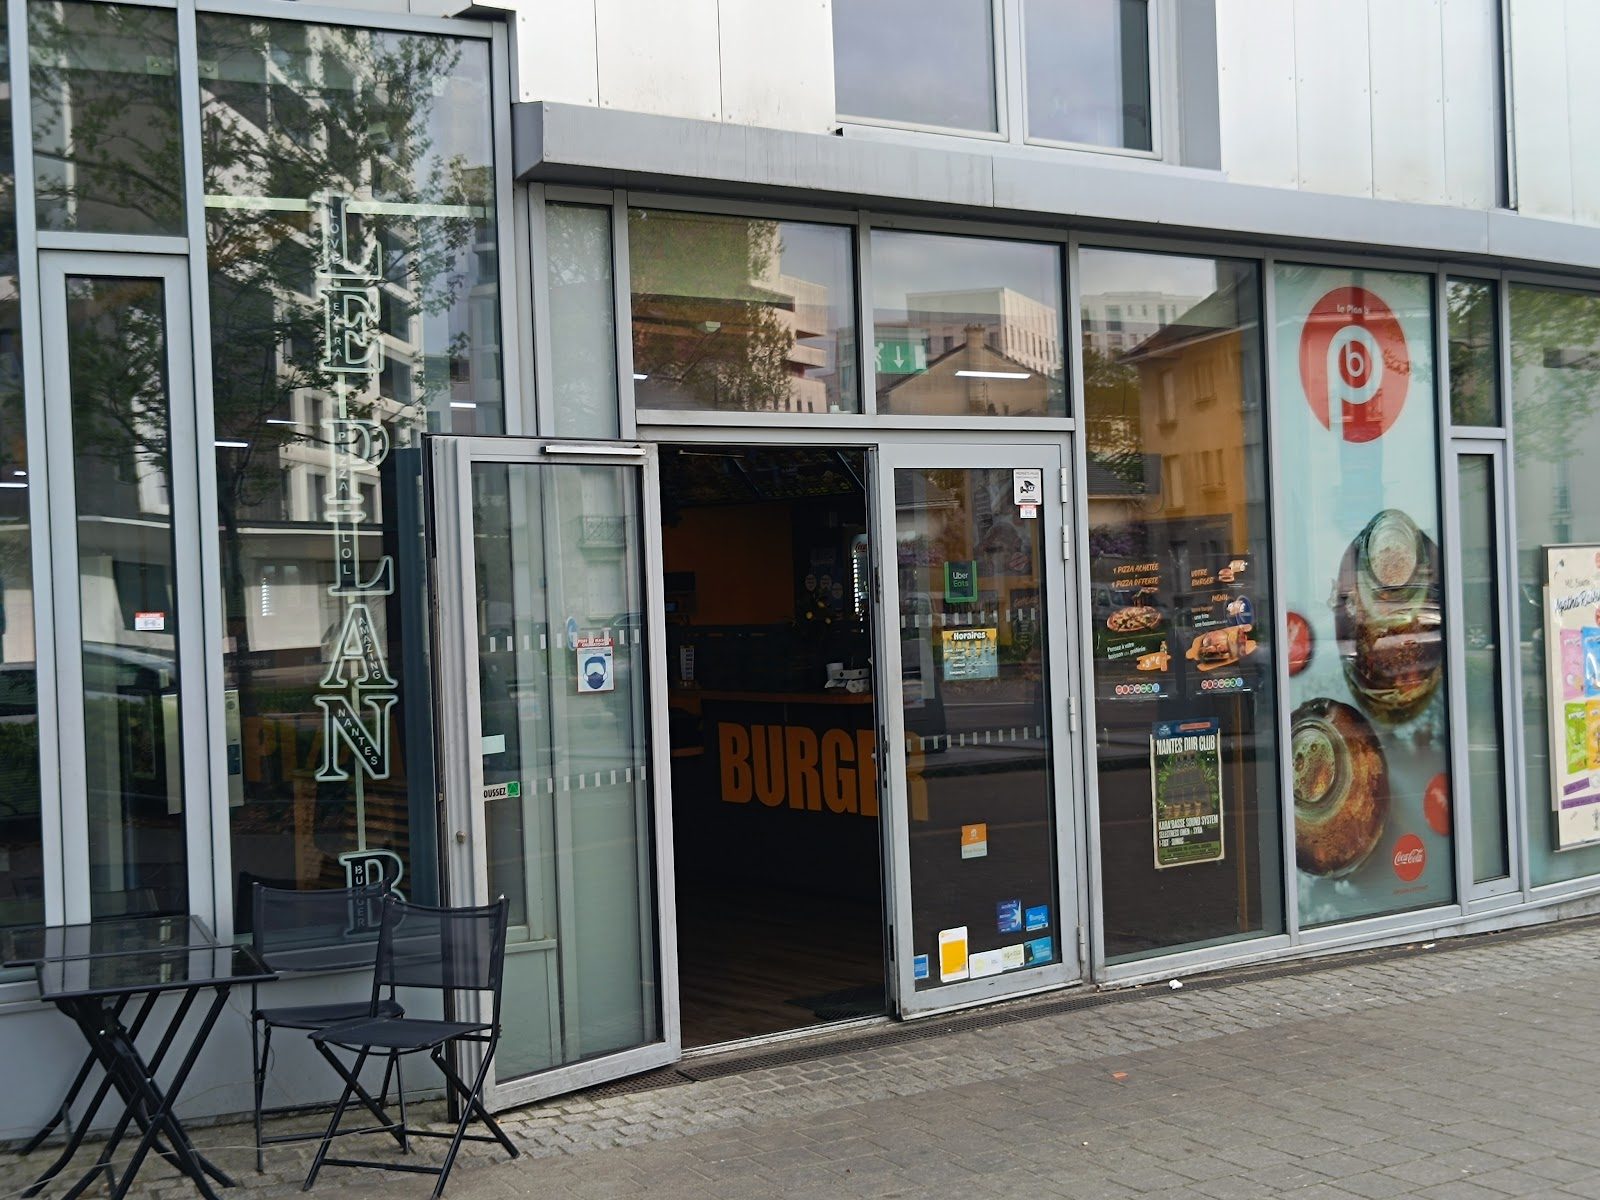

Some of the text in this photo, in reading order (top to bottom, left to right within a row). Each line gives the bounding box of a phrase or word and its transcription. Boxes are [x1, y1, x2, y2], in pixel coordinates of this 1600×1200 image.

[332, 302, 344, 359] EXTRA
[336, 431, 349, 492] PIZZA
[341, 533, 352, 576] LOL
[952, 571, 969, 580] Uber
[953, 580, 969, 588] Eats
[358, 617, 382, 680] AMAZING
[953, 631, 986, 641] Horaires
[338, 707, 378, 766] NANTES
[1156, 737, 1183, 756] NANTES
[1199, 734, 1216, 751] CLUB
[483, 786, 506, 798] OUSSEZ
